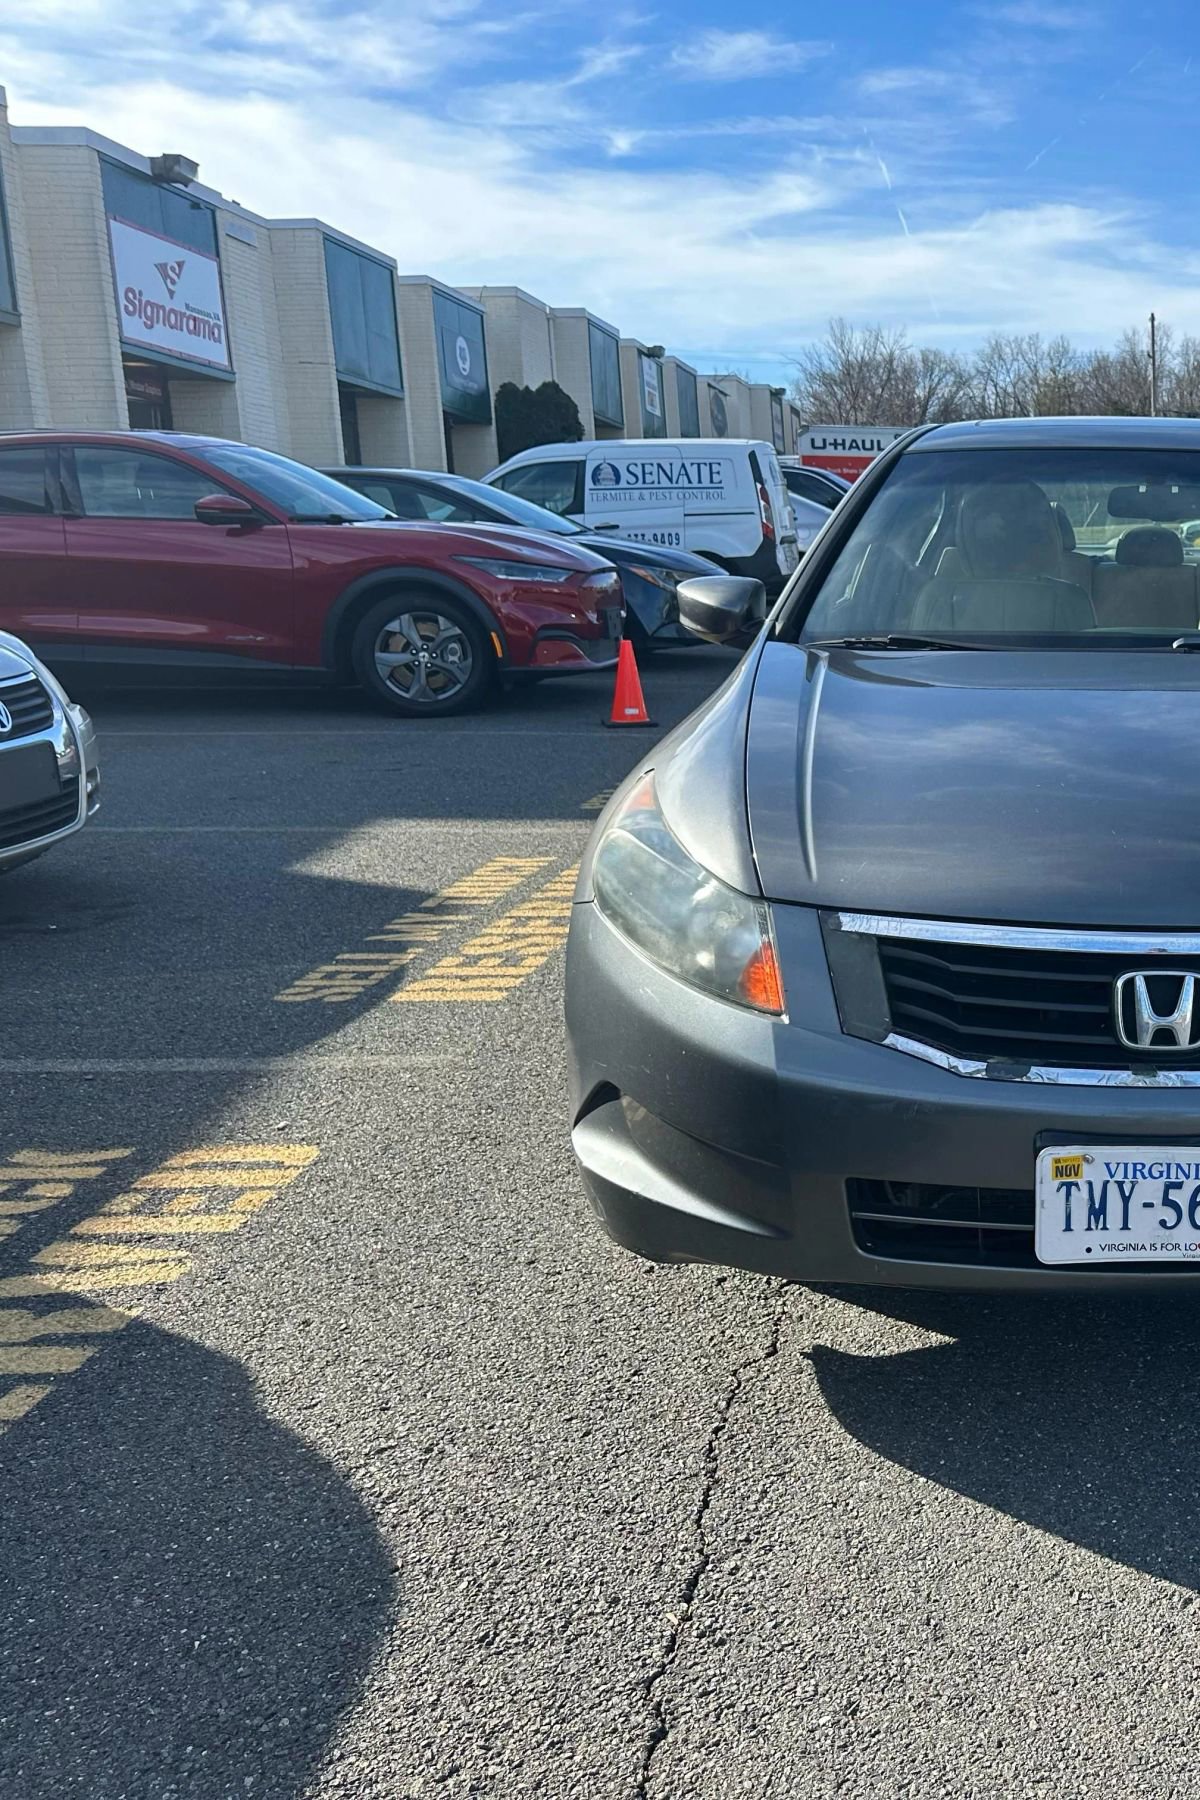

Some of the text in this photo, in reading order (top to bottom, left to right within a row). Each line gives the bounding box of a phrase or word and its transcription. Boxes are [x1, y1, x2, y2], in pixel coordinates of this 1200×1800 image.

[123, 287, 222, 344] Signarama
[811, 438, 884, 451] U-HAUL
[626, 462, 723, 486] SENATE
[590, 490, 726, 502] TERMITE & PEST CONTROL
[273, 856, 559, 1001] SELL MY TRUCK
[1055, 1164, 1081, 1178] NOV
[1099, 1243, 1147, 1252] VIRGINIA
[1149, 1243, 1158, 1252] IS
[1160, 1243, 1181, 1251] FOR
